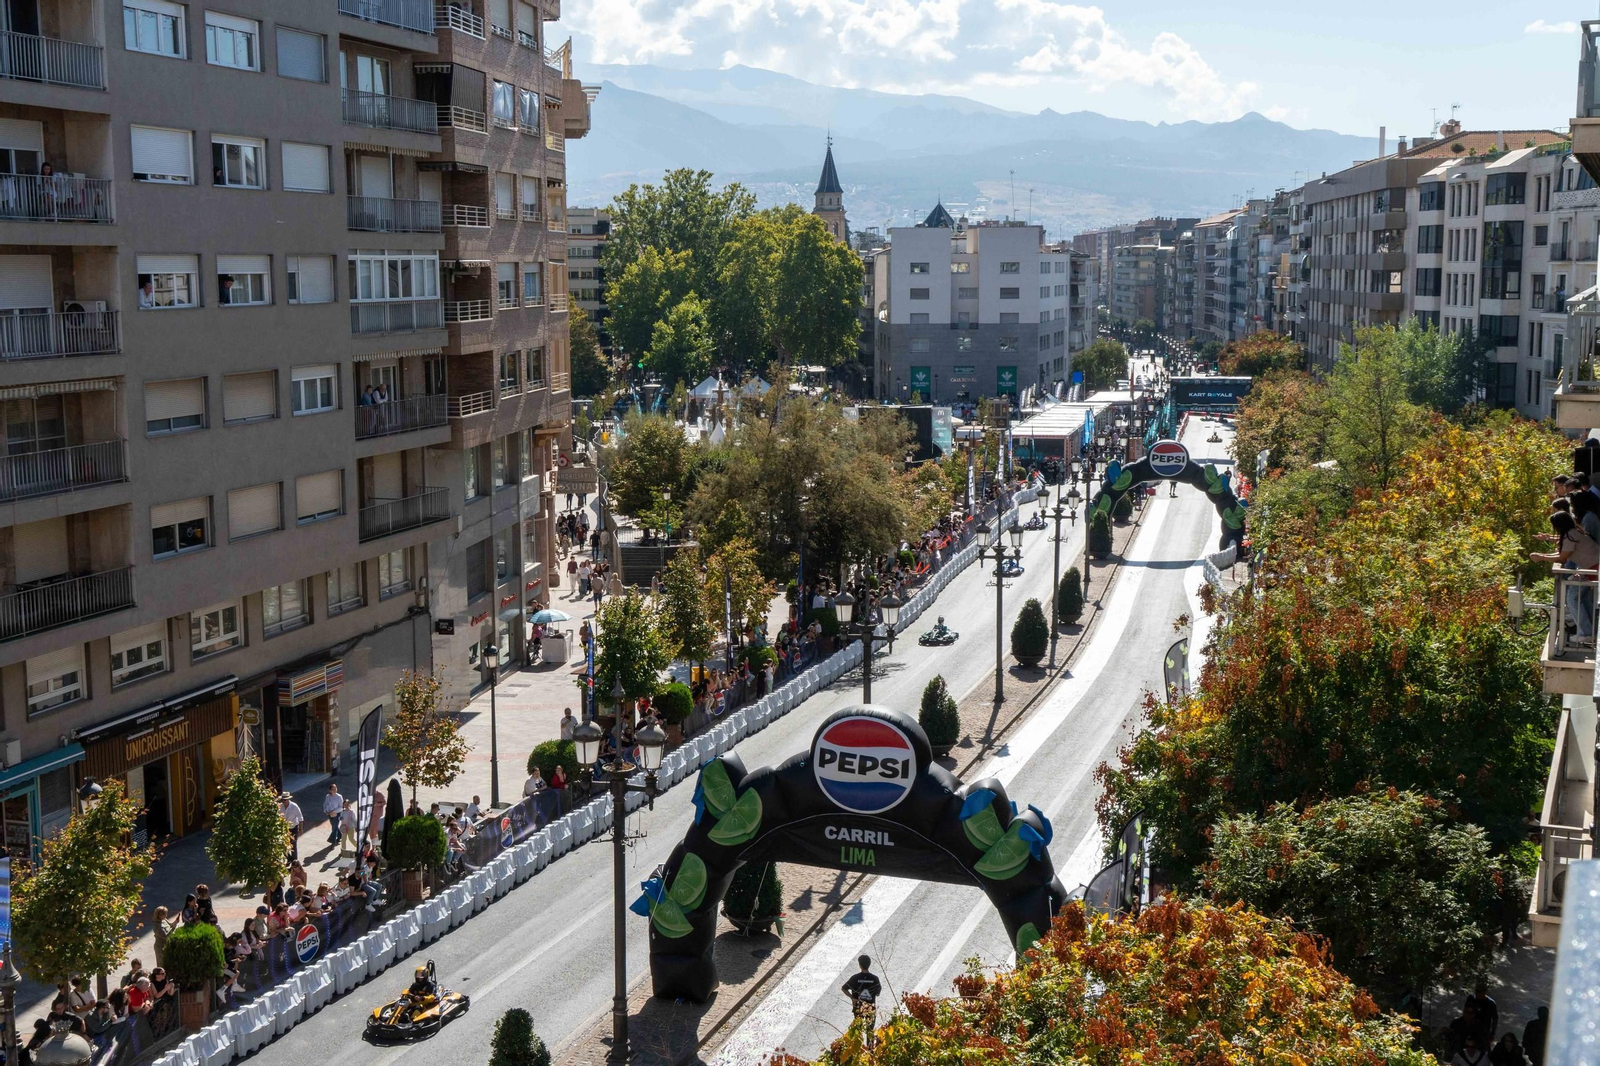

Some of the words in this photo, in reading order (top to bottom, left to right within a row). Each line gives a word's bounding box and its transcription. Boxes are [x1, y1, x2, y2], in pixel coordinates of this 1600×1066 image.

[1151, 453, 1185, 464] PEPSI
[125, 720, 190, 762] UNICROISSANT
[818, 747, 910, 779] PEPSI
[824, 825, 895, 847] CARRIL
[840, 846, 876, 867] LIMA
[297, 936, 319, 952] PEPSI
